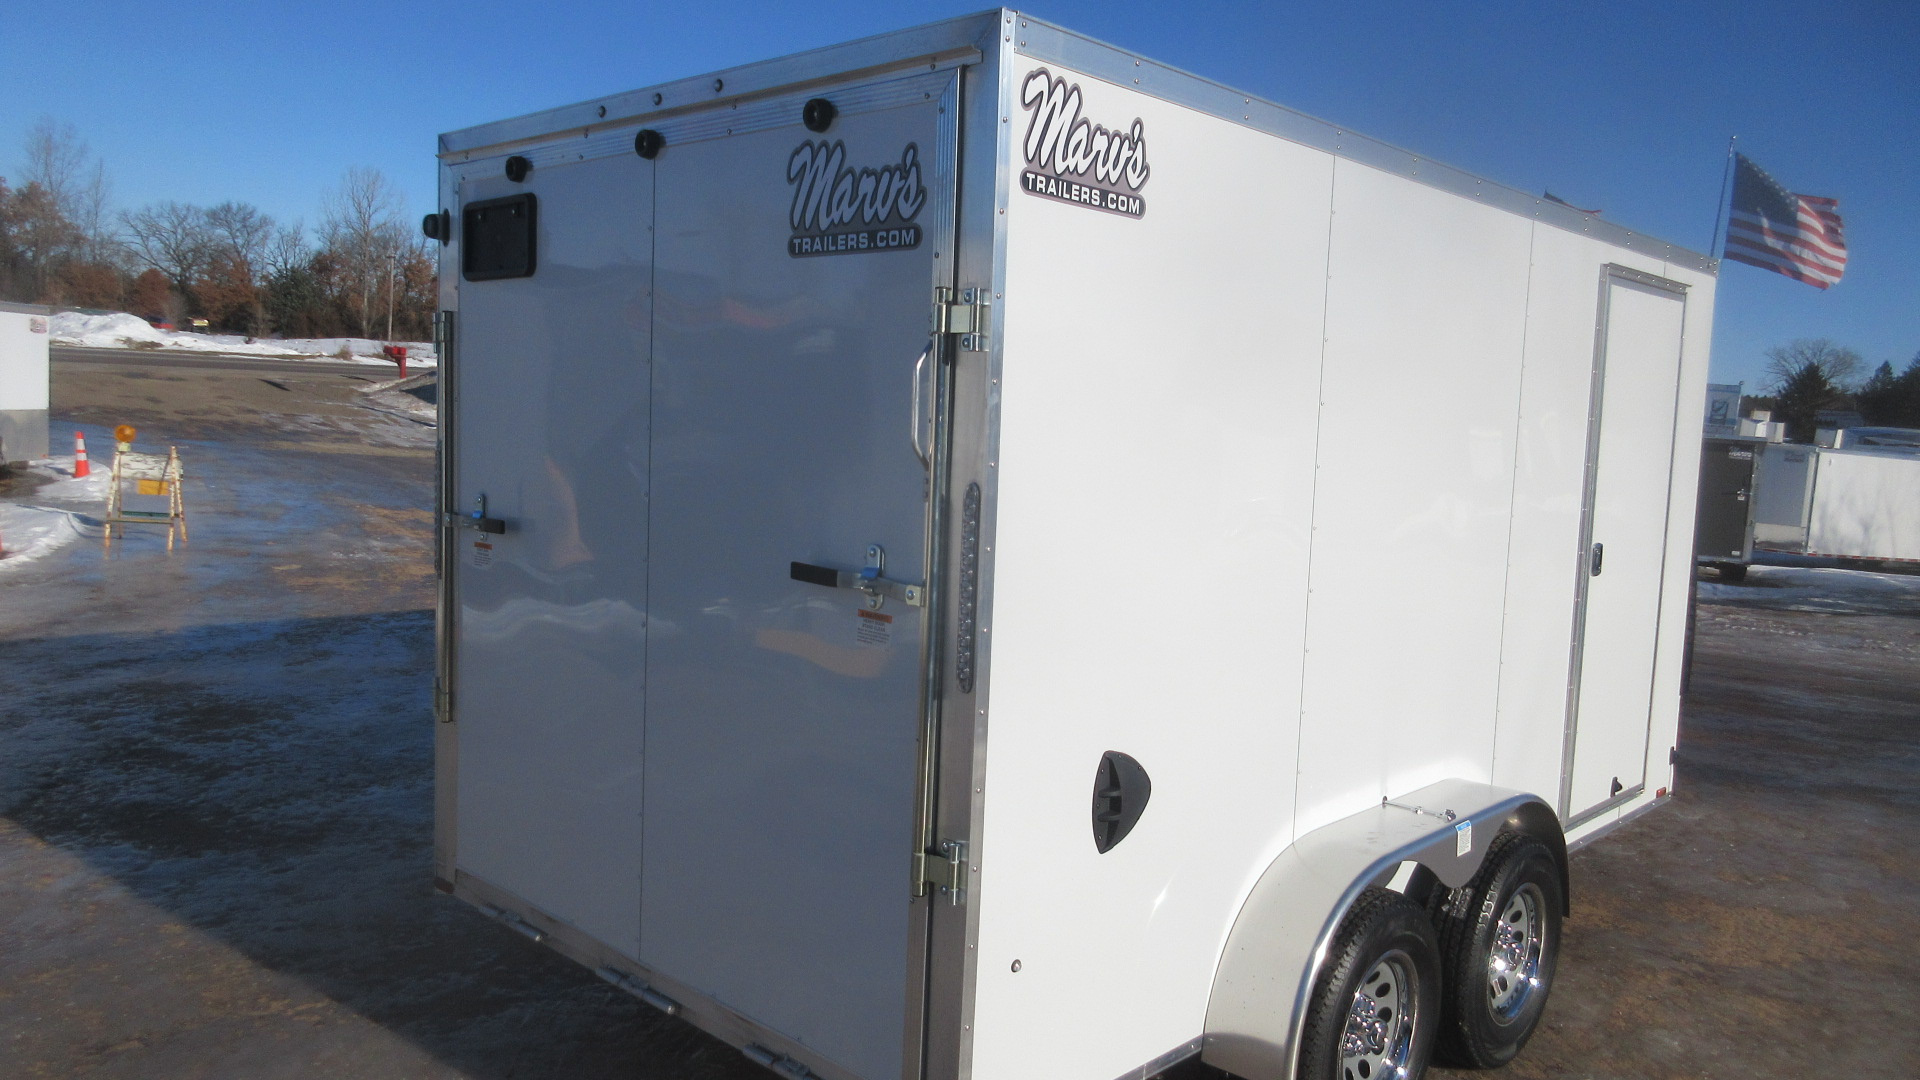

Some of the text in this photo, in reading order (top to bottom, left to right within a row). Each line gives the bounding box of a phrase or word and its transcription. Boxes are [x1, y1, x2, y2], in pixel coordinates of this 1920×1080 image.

[1023, 69, 1149, 190] Marv's
[788, 141, 925, 231] Marv's
[1026, 172, 1140, 215] TRAILERS.COM
[793, 228, 915, 254] TRAILERS.COM
